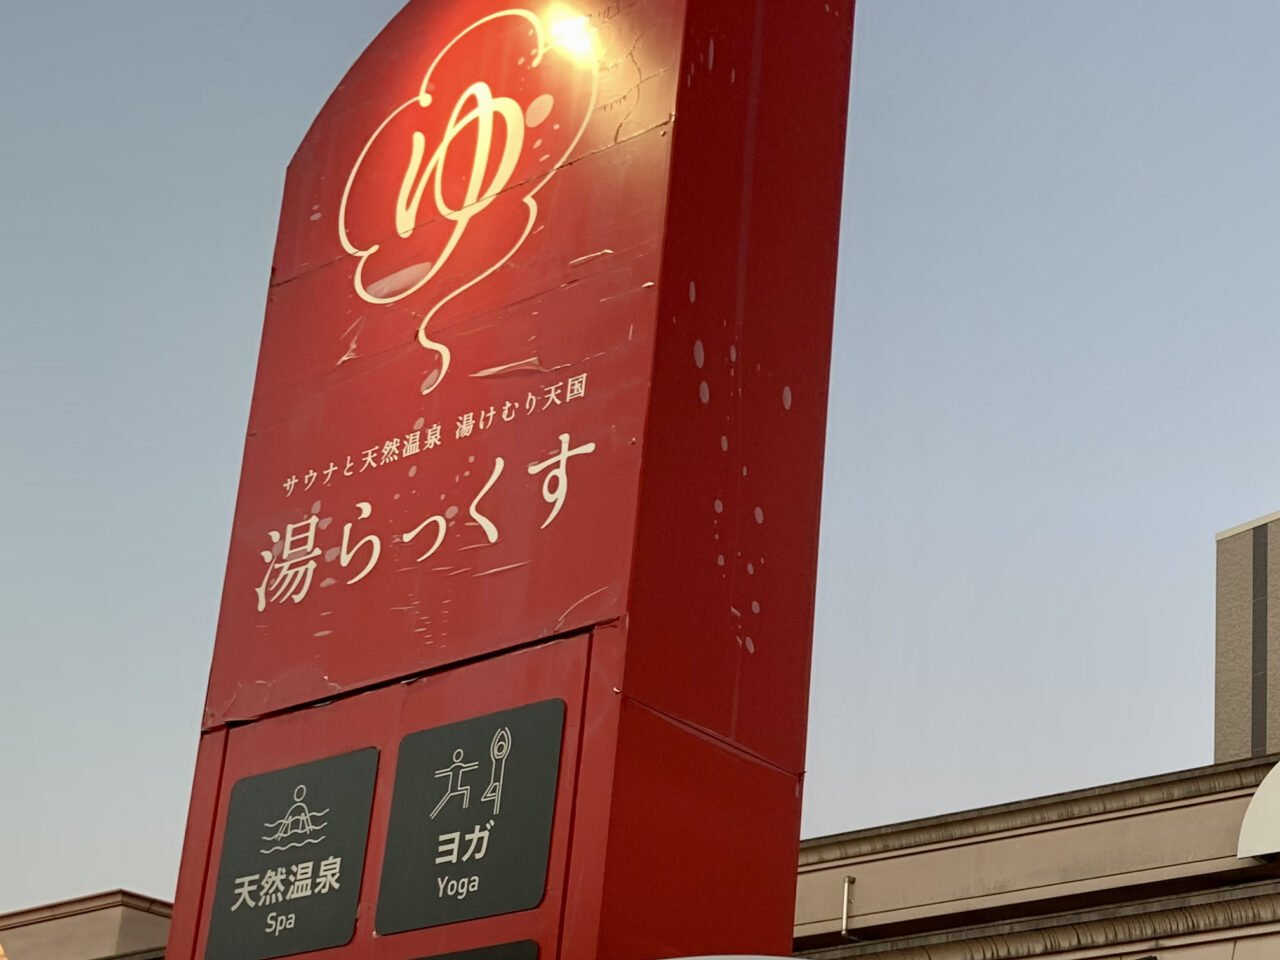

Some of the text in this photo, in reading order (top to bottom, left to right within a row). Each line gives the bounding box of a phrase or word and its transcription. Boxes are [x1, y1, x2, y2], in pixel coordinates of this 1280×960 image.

[283, 373, 588, 497] サウナと天然温泉 湯けむり天国
[256, 433, 596, 612] 湯らっくす
[435, 819, 496, 865] ヨガ
[231, 856, 342, 912] 天然温泉
[436, 872, 480, 900] Yoga
[264, 911, 296, 936] Spa
